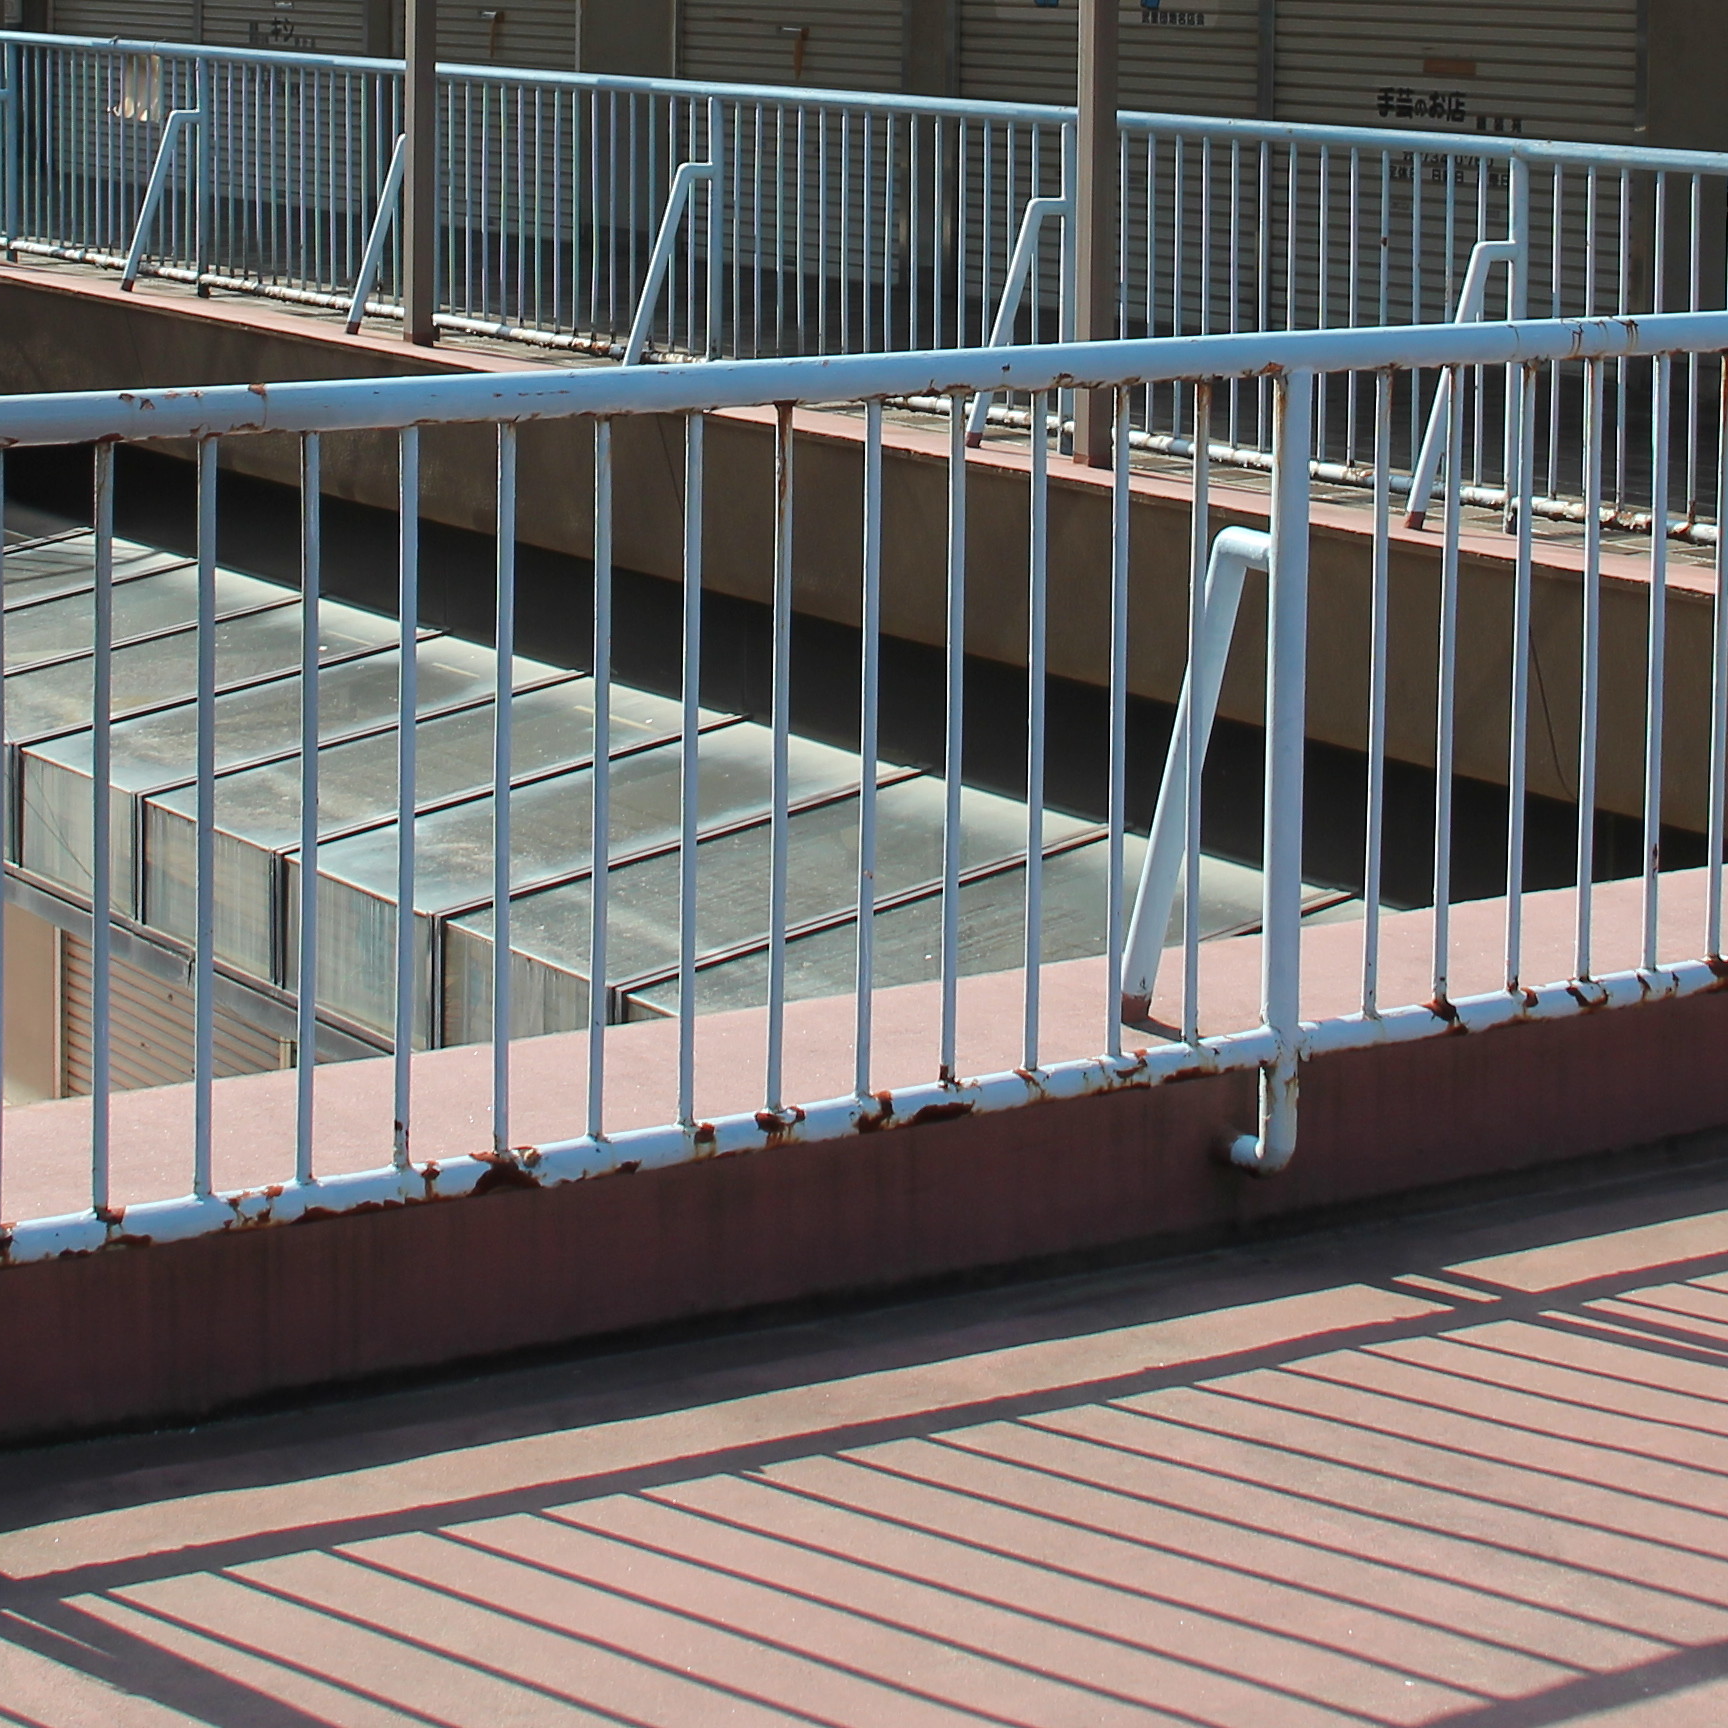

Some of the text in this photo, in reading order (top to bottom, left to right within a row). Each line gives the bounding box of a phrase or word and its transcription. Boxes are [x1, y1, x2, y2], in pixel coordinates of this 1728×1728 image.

[1377, 87, 1467, 122] 手芸のお店
